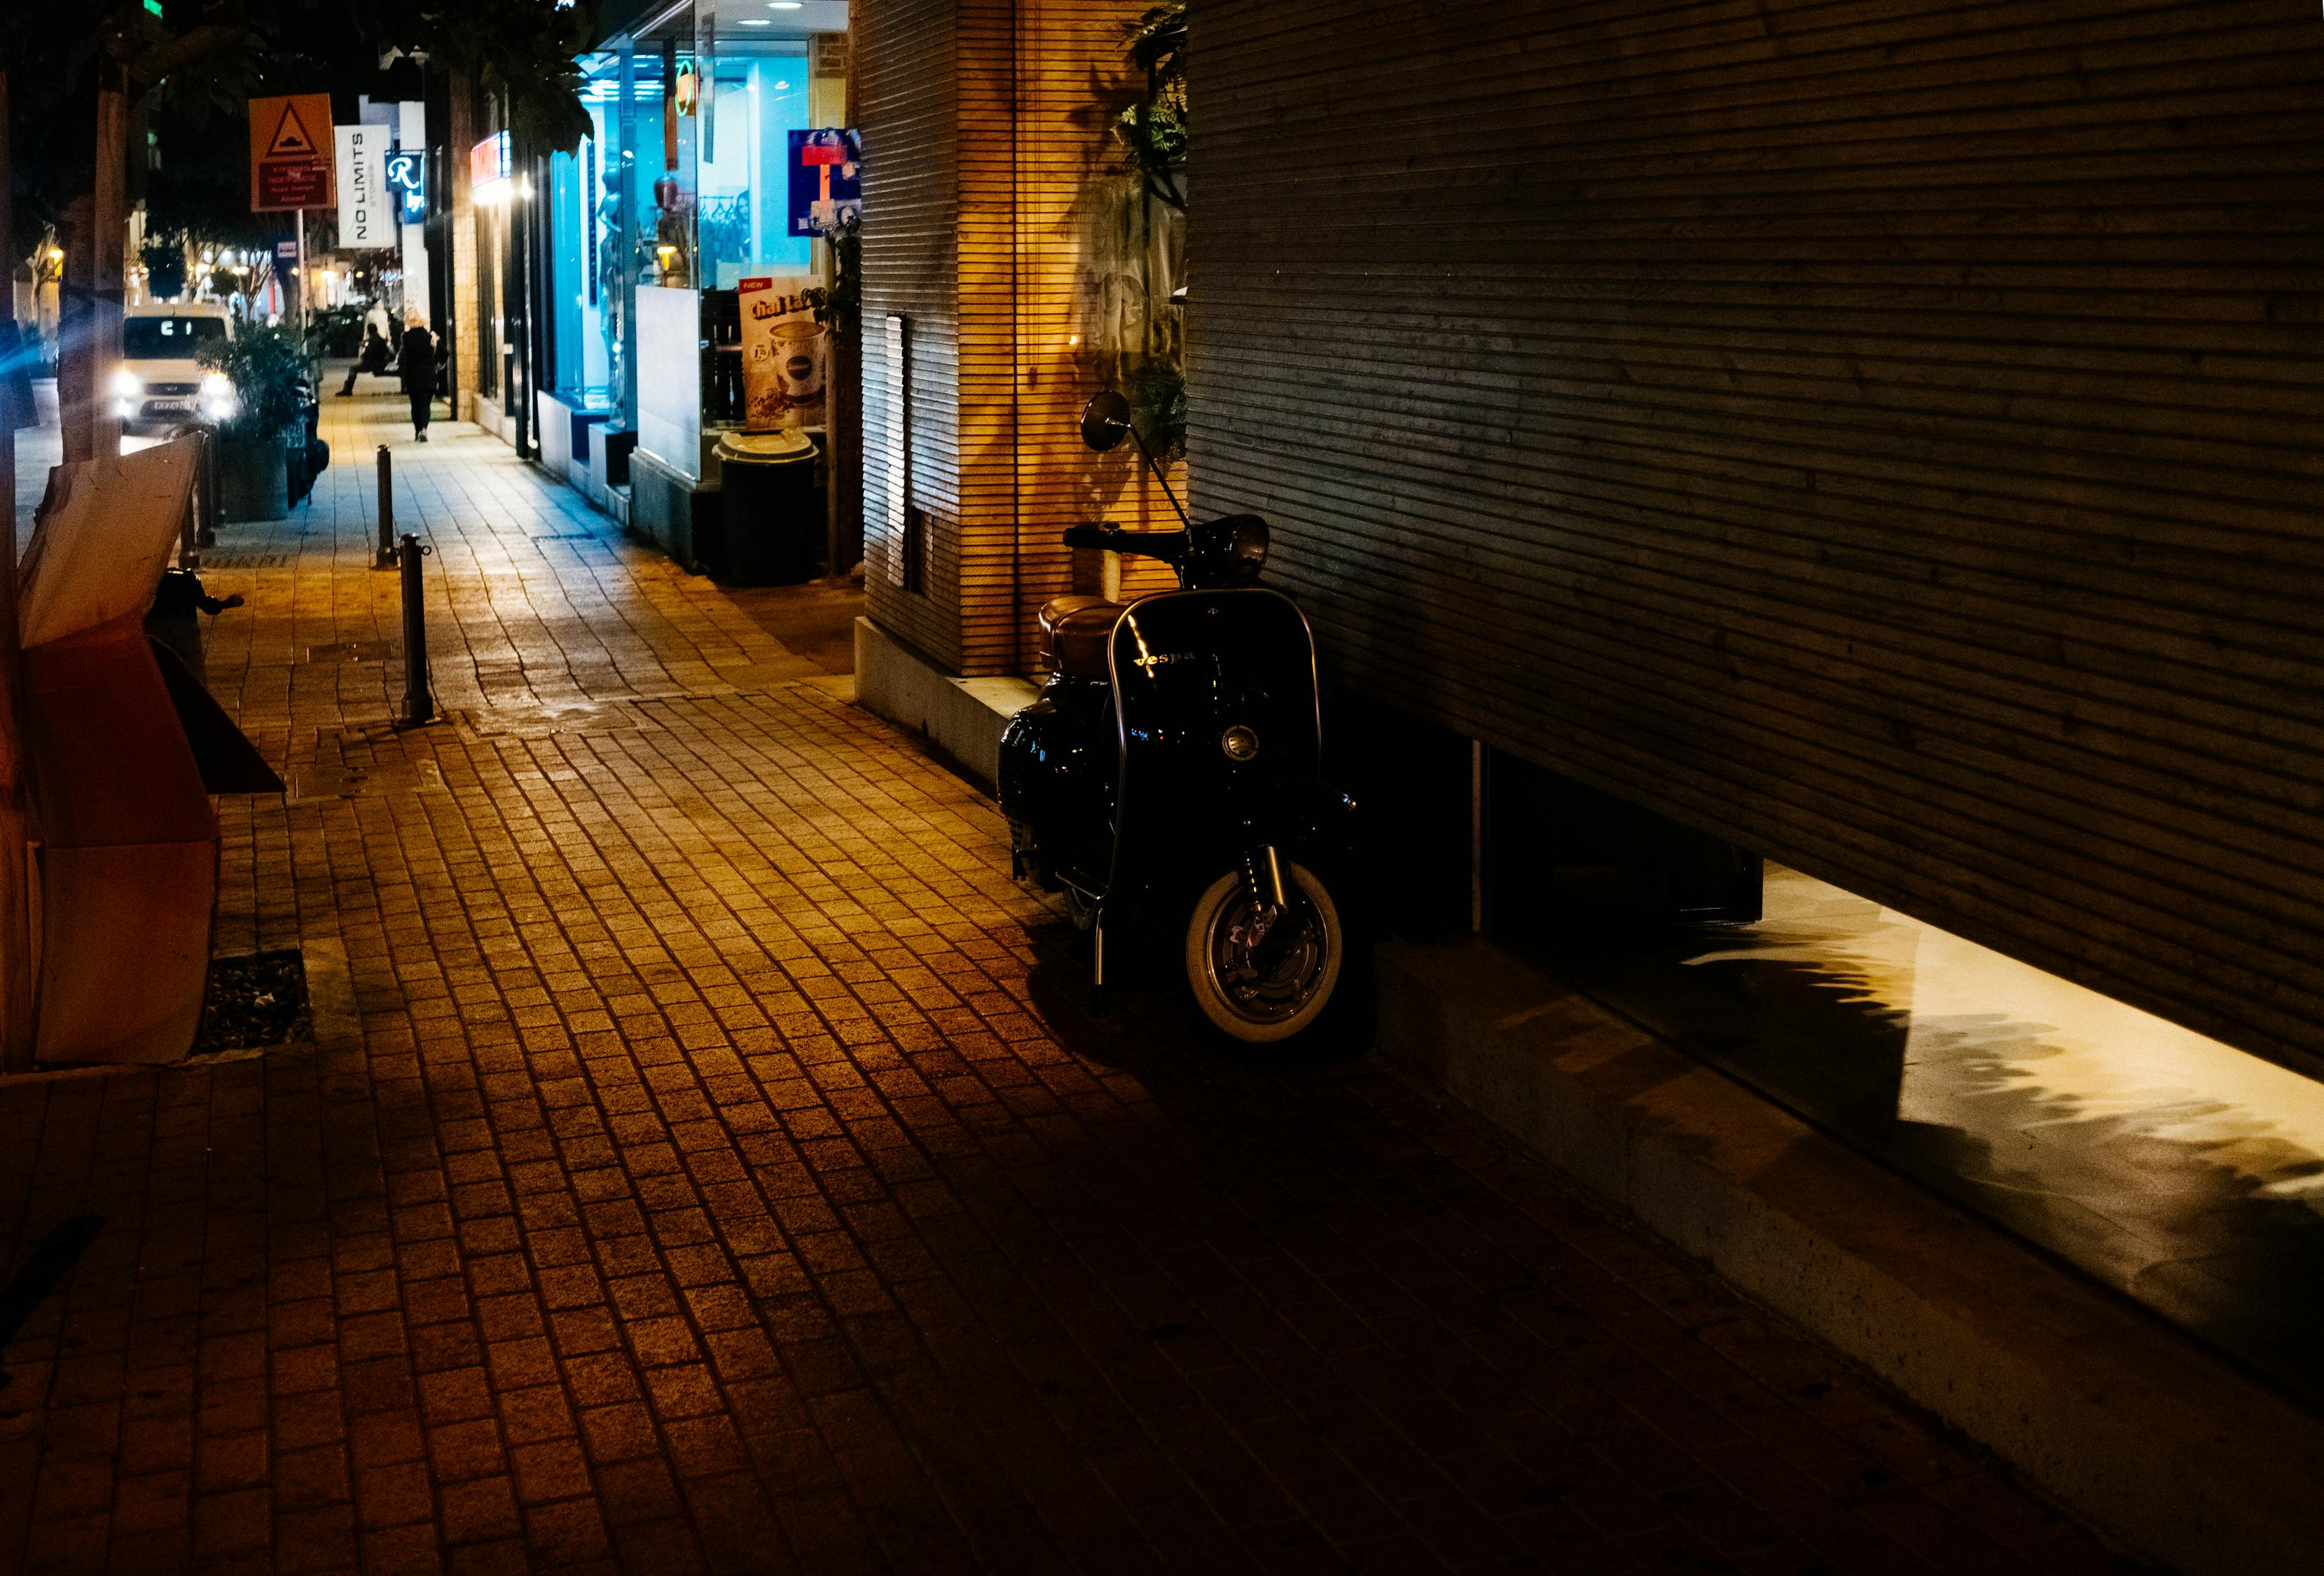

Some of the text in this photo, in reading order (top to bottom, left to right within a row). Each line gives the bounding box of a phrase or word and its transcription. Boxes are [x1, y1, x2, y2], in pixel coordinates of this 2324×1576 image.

[352, 132, 367, 240] NO LIMITS
[743, 281, 764, 289] NEW
